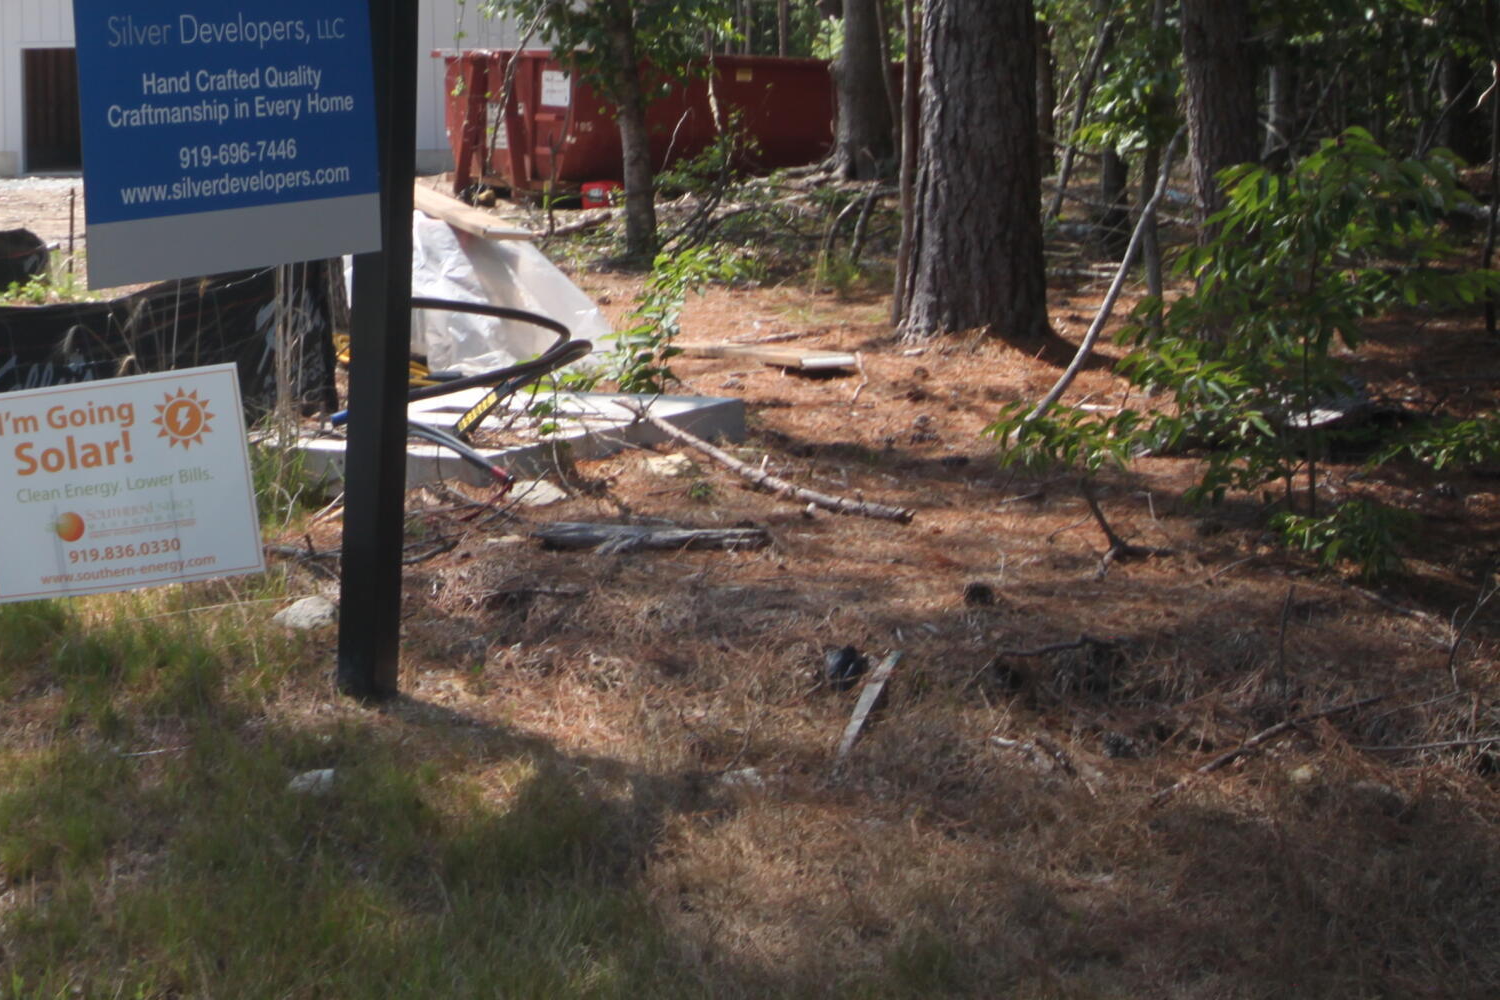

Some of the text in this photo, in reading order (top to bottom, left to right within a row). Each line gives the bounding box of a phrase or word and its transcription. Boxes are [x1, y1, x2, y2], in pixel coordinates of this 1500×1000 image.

[107, 12, 345, 49] Silver Developers, LLC
[142, 65, 322, 95] Hand Crafted Quality
[107, 92, 354, 128] Craftmanship in Every Home
[179, 138, 298, 169] 919-696-7446
[120, 165, 350, 205] www.silverdevelopers.com
[45, 400, 135, 430] Going
[14, 430, 135, 477] Solar!
[16, 467, 215, 504] Clean Energy. Lower Bills.
[68, 538, 182, 564] 919.836.0330
[40, 555, 217, 586] www.southern-energy.com
